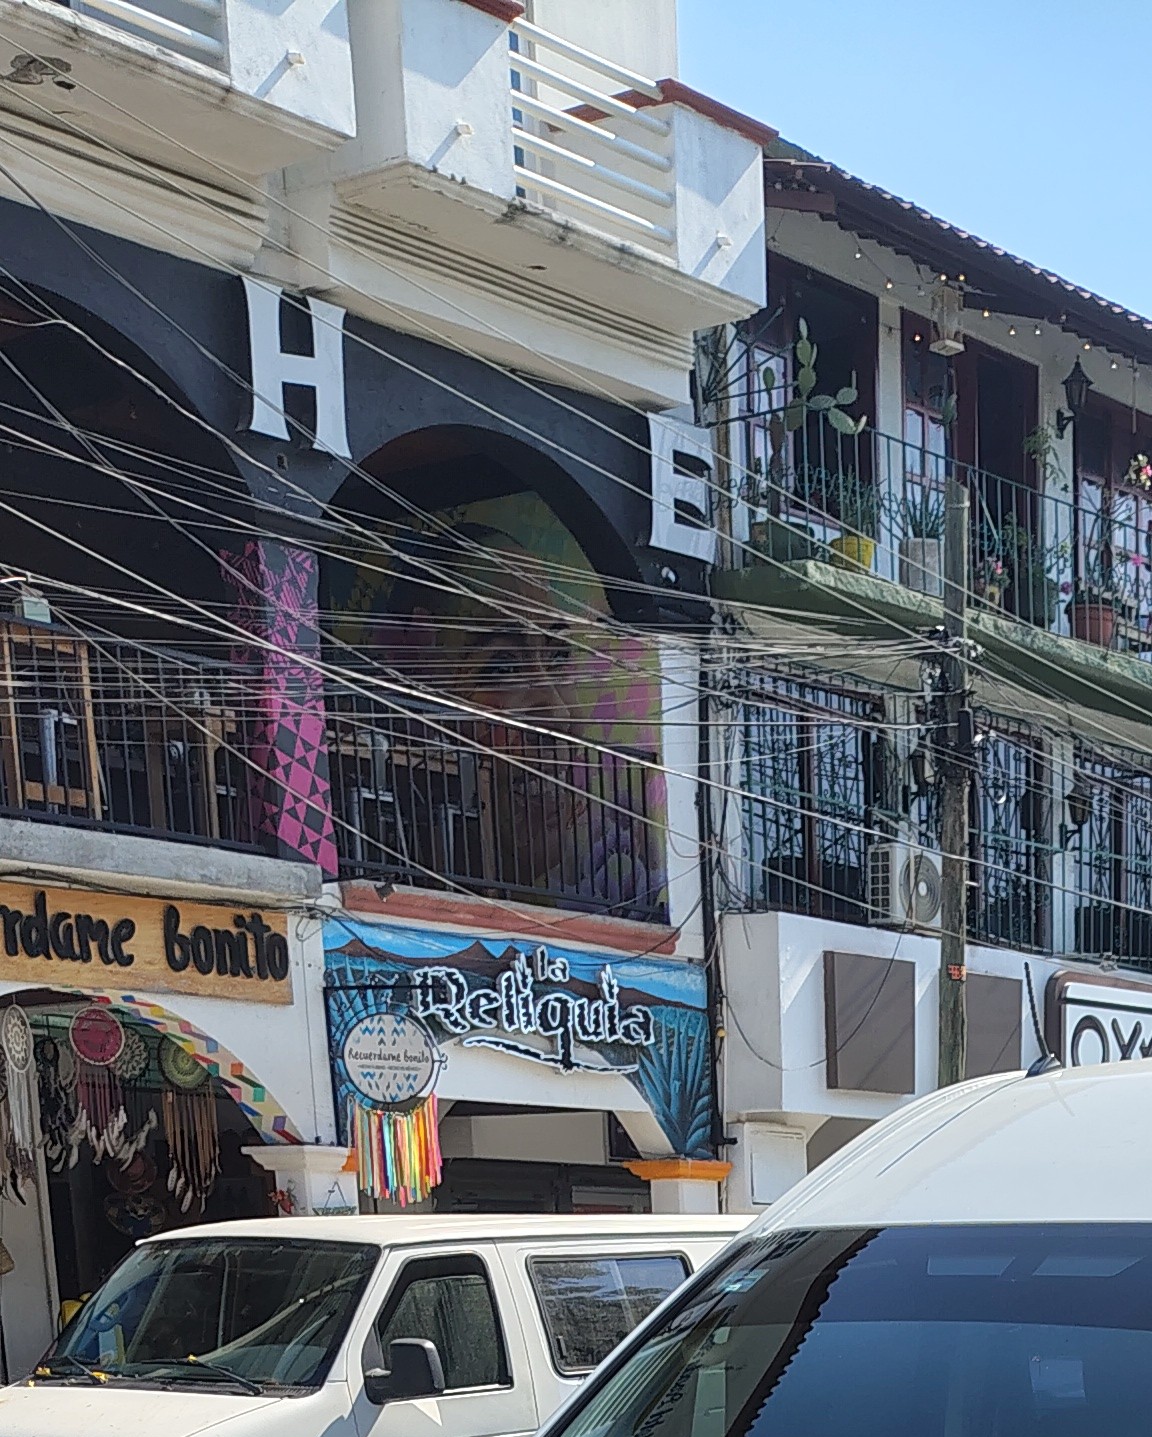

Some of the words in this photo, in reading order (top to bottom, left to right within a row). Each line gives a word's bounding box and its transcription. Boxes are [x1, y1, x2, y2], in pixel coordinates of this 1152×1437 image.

[164, 903, 289, 981] bonito
[537, 945, 569, 983] la
[412, 953, 656, 1075] Reliquia
[404, 1048, 430, 1063] bonito
